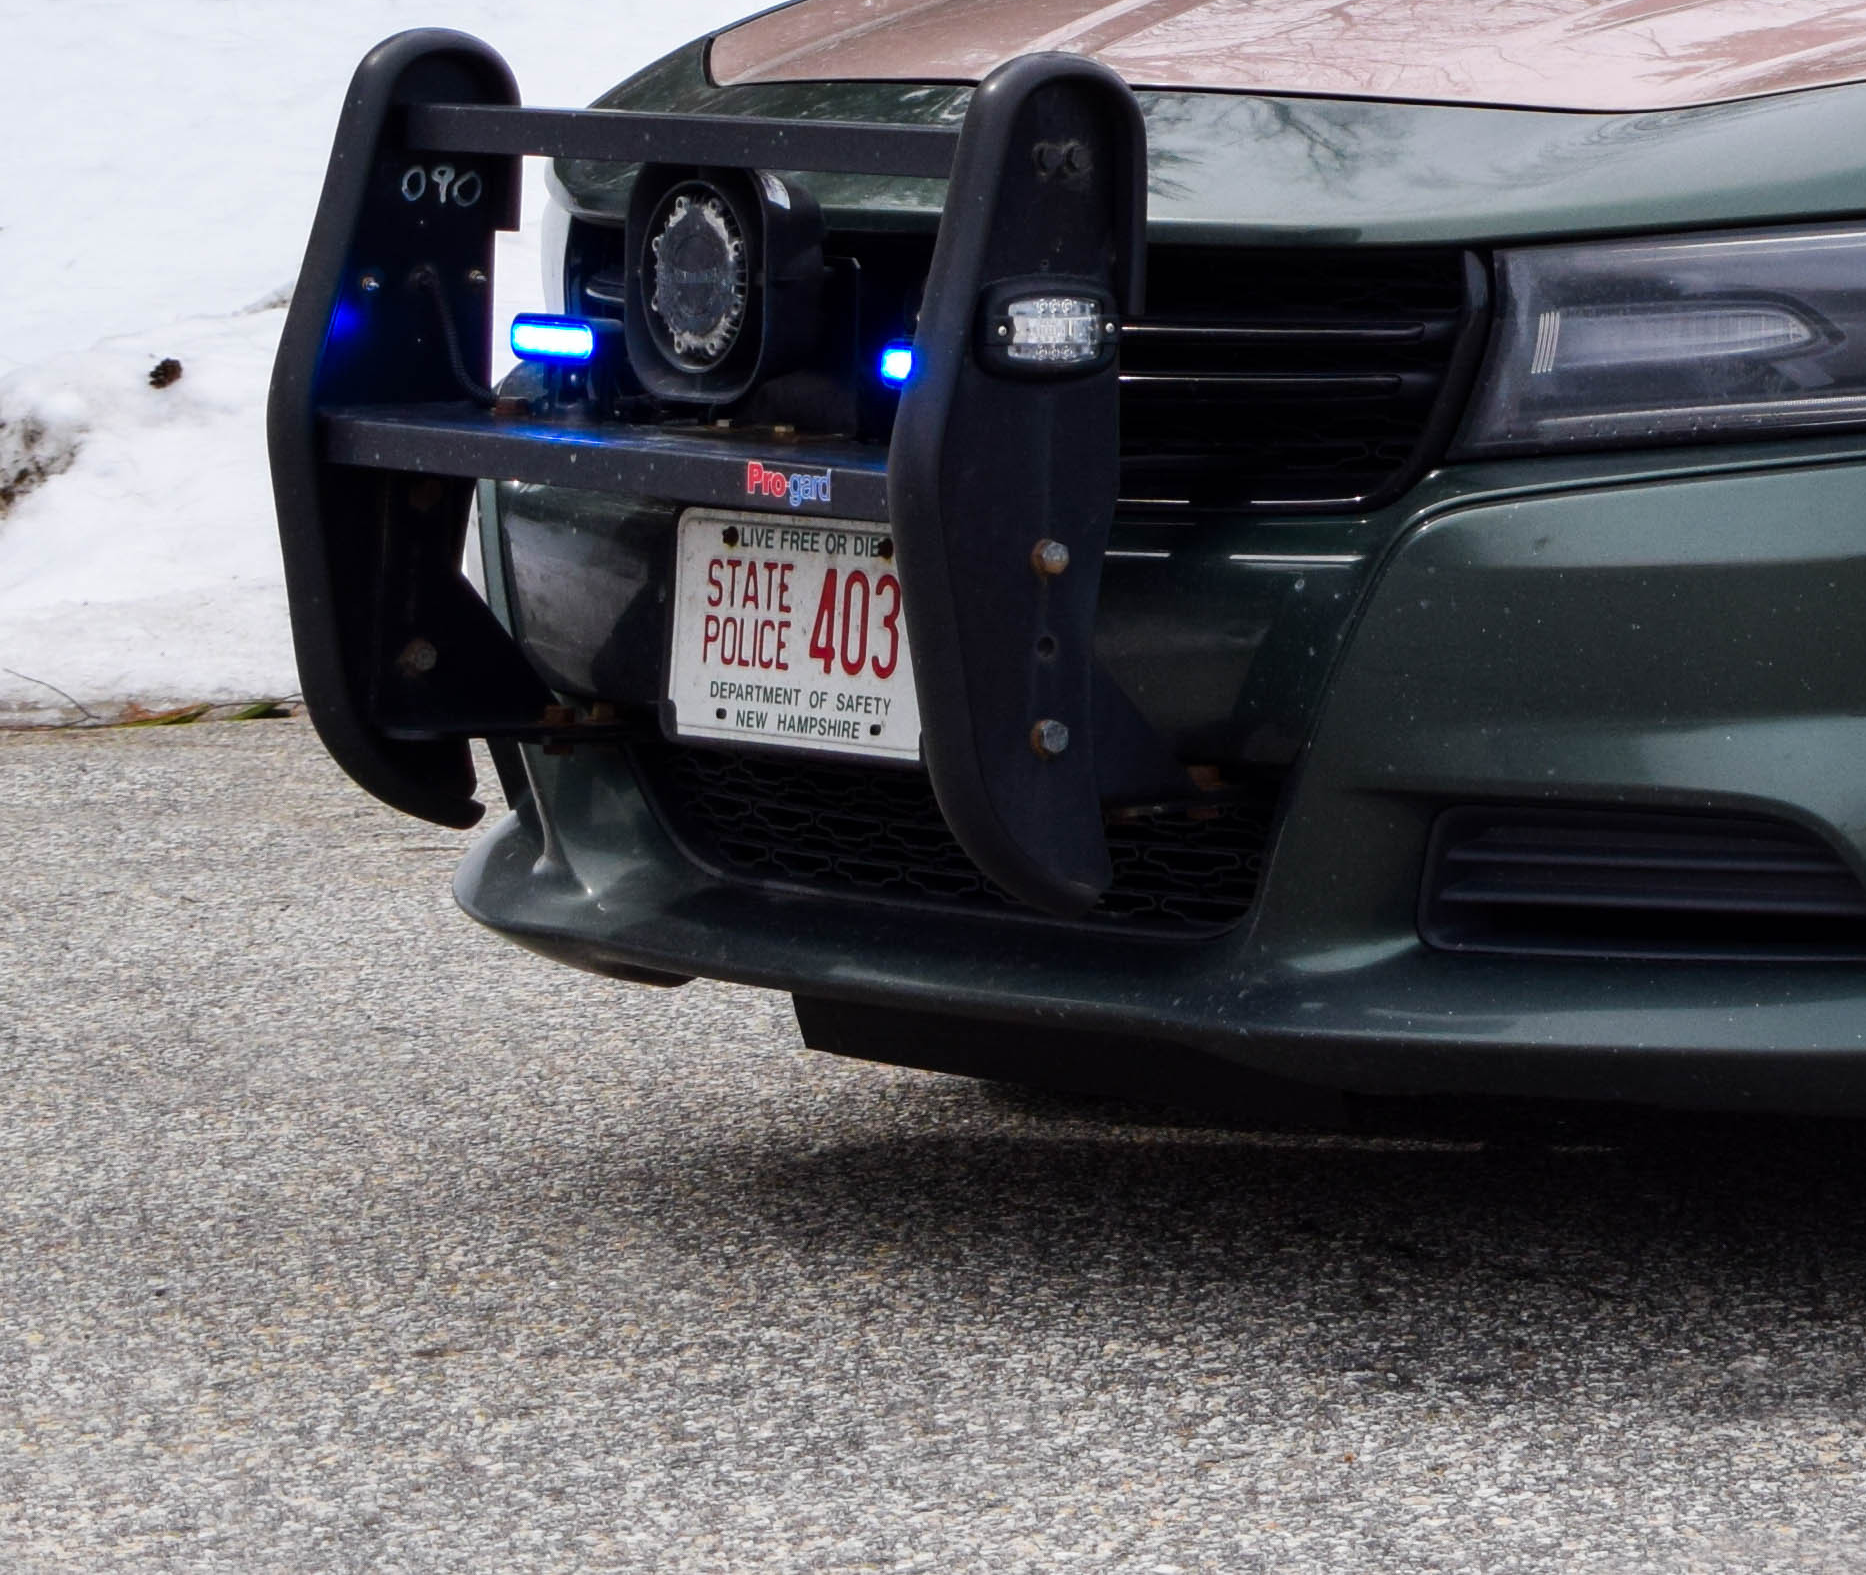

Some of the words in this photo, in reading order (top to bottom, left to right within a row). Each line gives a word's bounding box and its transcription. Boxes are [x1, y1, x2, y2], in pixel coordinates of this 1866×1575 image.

[401, 165, 482, 207] 090
[746, 460, 832, 506] Pro-gard
[740, 527, 775, 549] LIVE
[780, 530, 820, 553] FREE
[825, 533, 847, 555] OR
[853, 536, 881, 558] DIE
[707, 559, 794, 613] STATE
[703, 614, 791, 671] POLICE
[809, 568, 901, 679] 403
[709, 680, 802, 706] DEPARTMENT
[809, 691, 828, 709] OF
[836, 693, 892, 716] SAFETY
[735, 709, 768, 729] NEW
[776, 713, 861, 740] HAMPSHIRE
